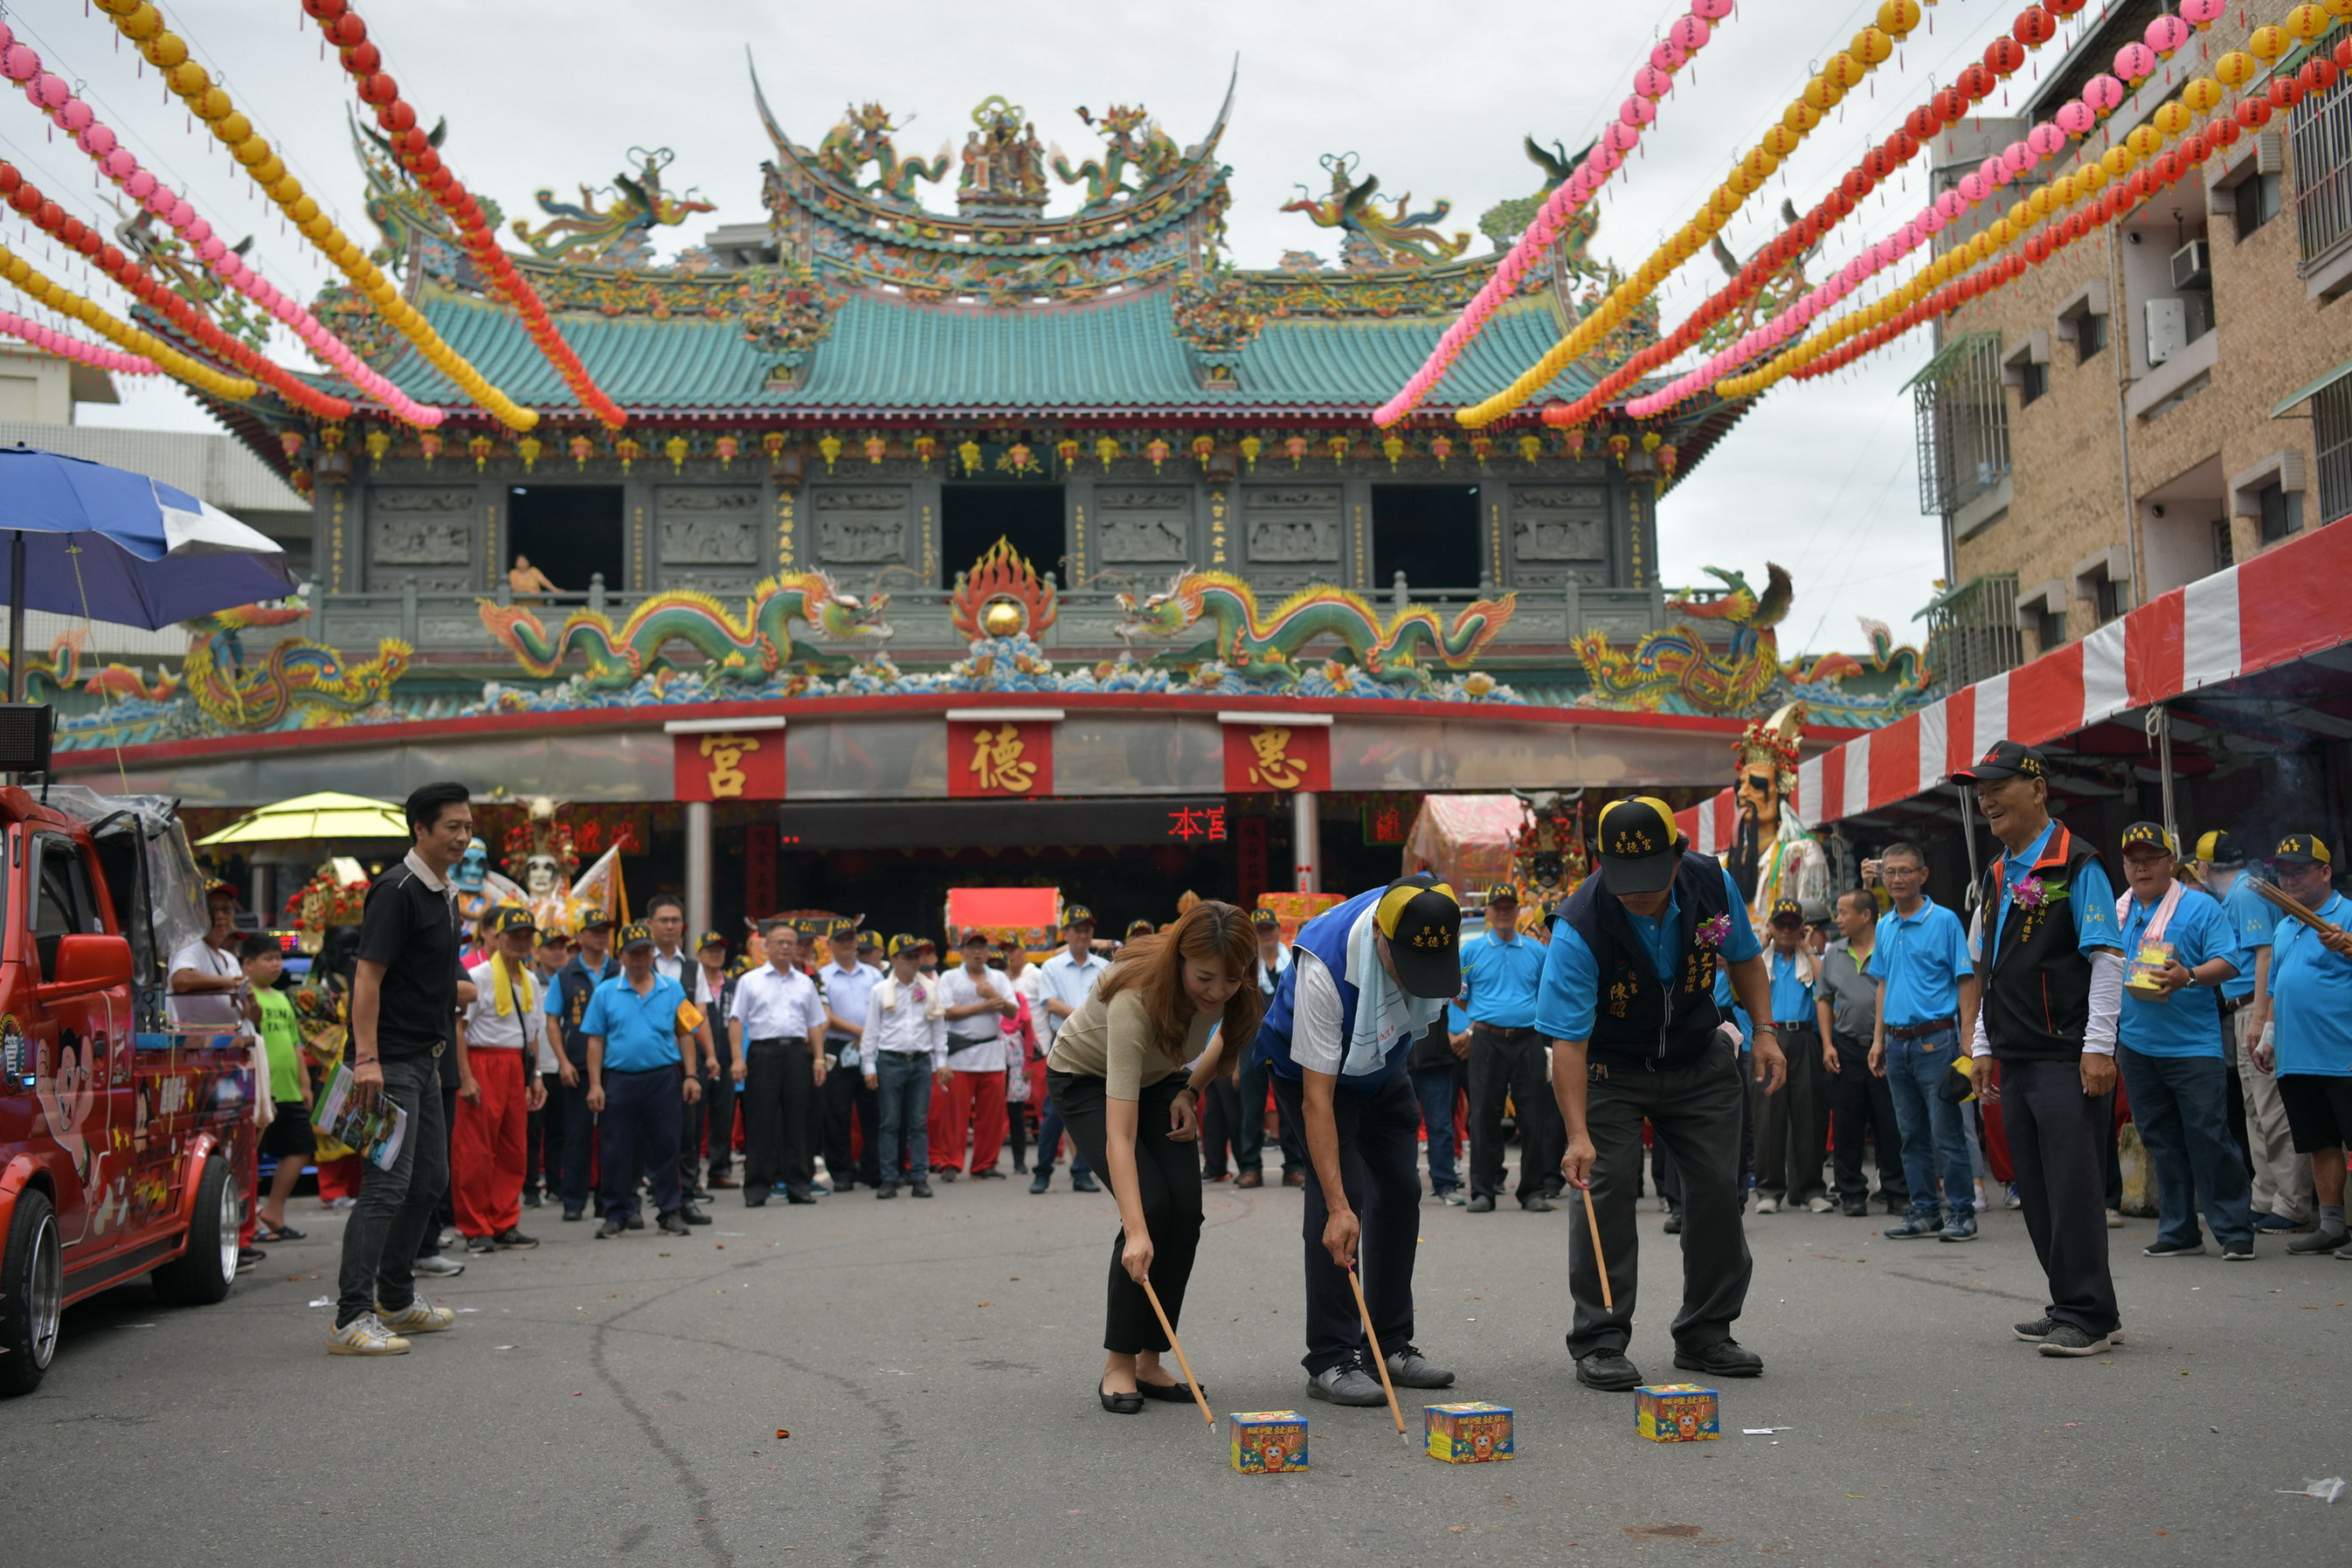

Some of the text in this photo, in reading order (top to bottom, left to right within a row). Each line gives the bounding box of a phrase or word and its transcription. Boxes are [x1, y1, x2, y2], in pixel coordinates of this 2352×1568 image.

[699, 732, 761, 799] 宮
[1620, 830, 1644, 842] 草屯
[1615, 839, 1651, 853] 惠德宮
[1422, 926, 1447, 936] 草屯
[1413, 934, 1451, 948] 惠德宮
